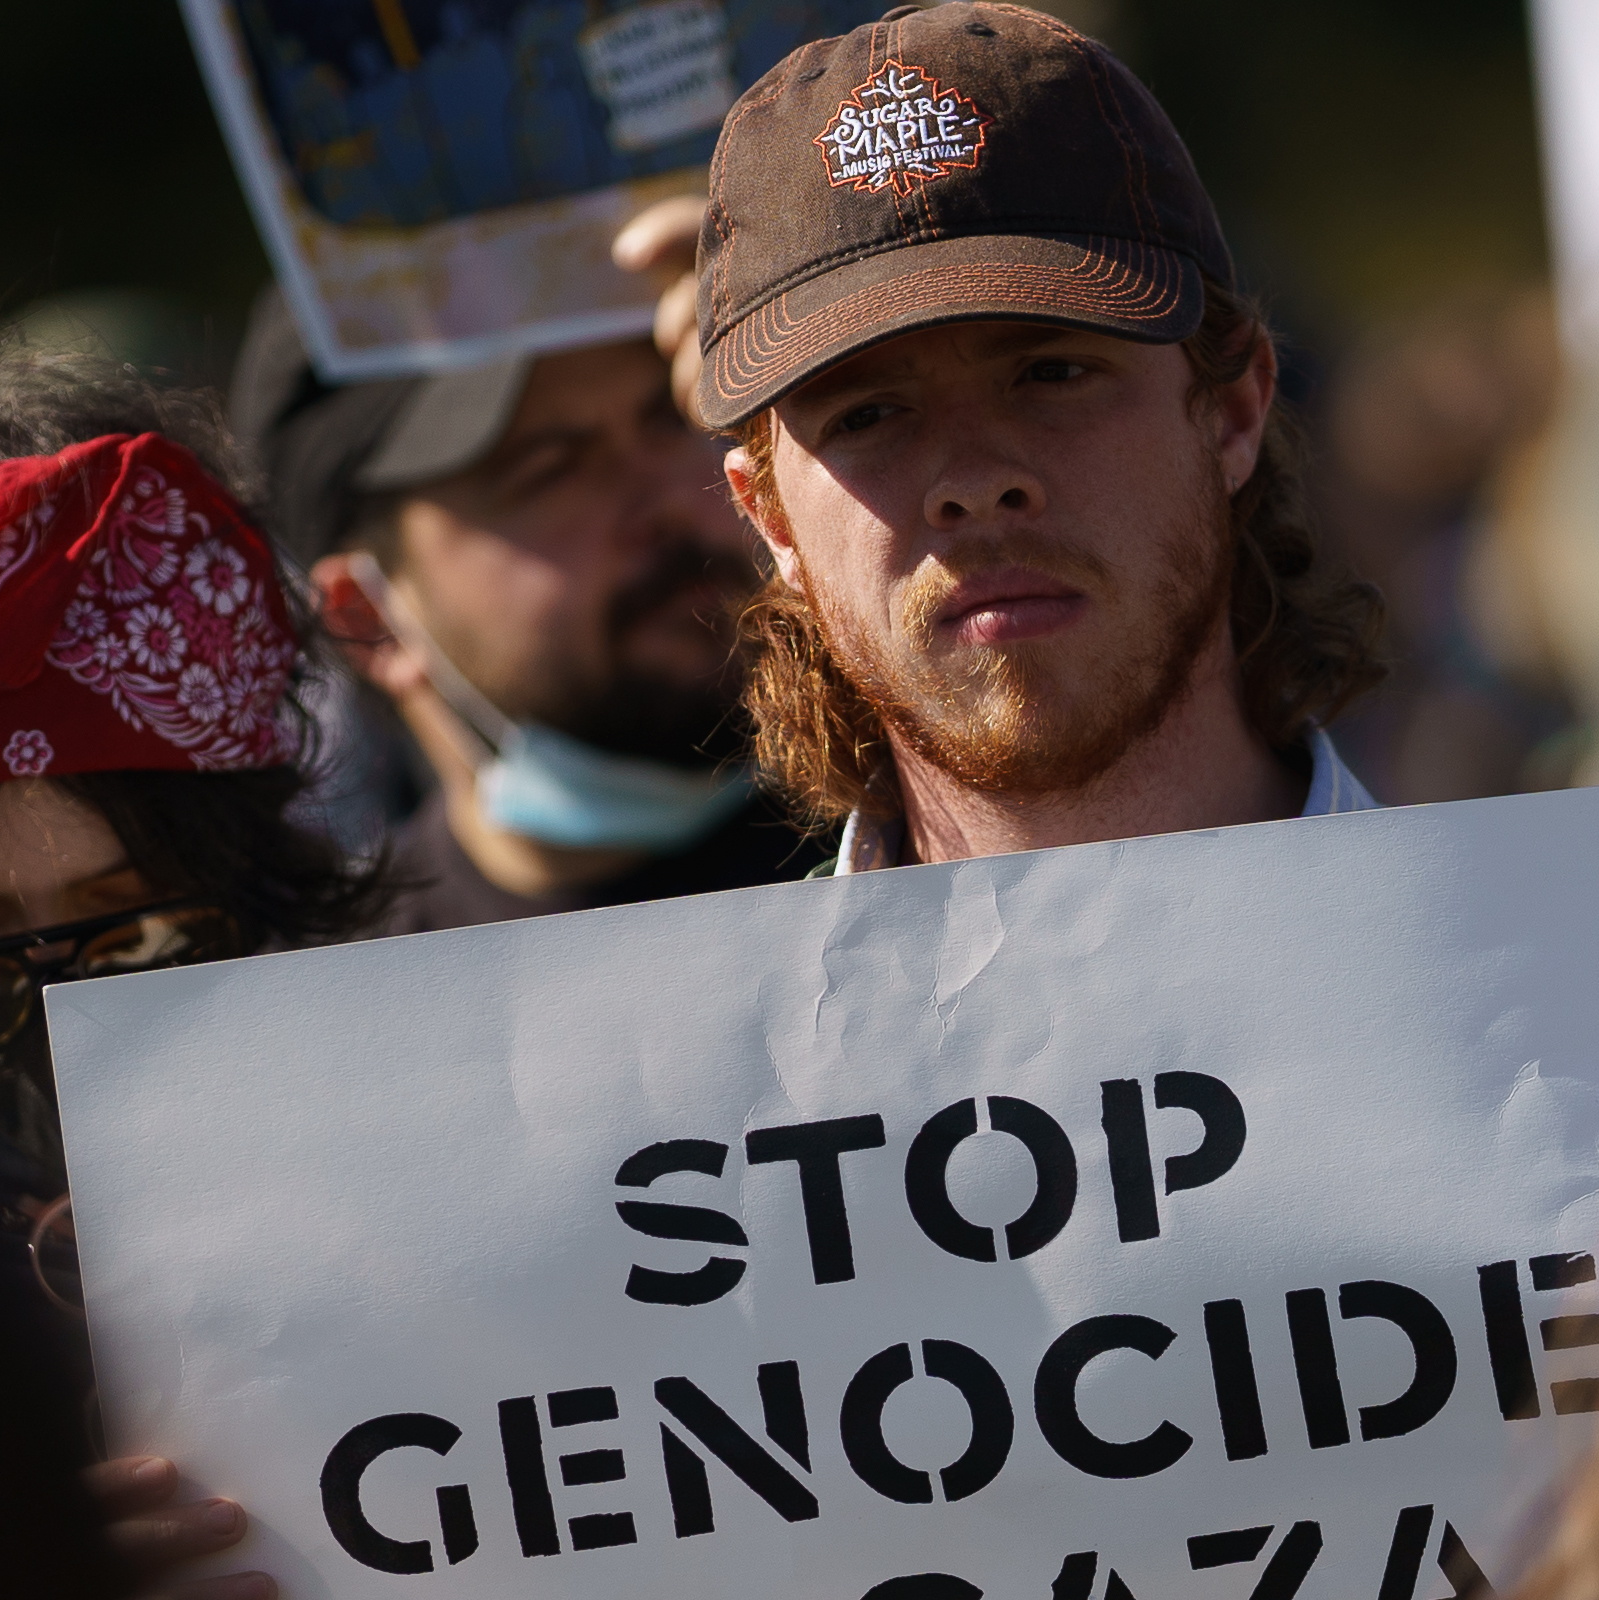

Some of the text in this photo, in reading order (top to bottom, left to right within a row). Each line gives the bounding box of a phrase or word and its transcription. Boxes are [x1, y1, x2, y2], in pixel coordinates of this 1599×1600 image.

[833, 97, 956, 145] SUGAR
[837, 114, 963, 165] MAPLE
[842, 143, 967, 179] MUSIC FESTIVAL
[612, 1069, 1248, 1307] STOP
